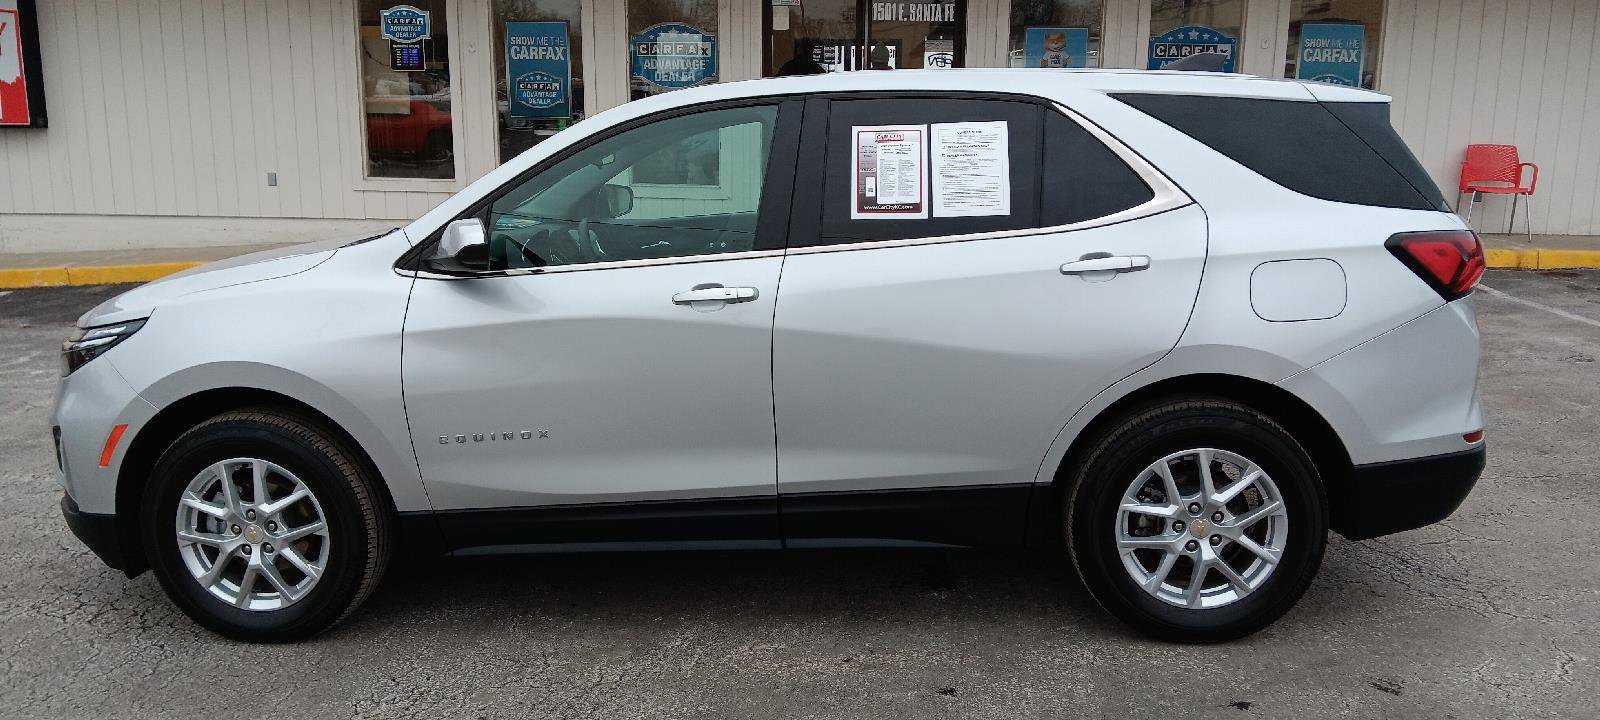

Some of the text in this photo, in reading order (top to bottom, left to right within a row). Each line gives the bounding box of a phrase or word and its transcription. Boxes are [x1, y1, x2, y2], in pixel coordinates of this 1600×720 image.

[872, 3, 955, 21] 1501 E. SANTA FE
[510, 36, 565, 46] SHOW ME THE
[1304, 39, 1359, 49] SHOW ME THE
[510, 46, 566, 60] CARFAX
[639, 44, 709, 56] CARFAX
[1303, 49, 1358, 63] CARFAX
[643, 60, 706, 70] ADVANTAGE
[655, 72, 695, 82] DEALER
[438, 429, 549, 444] EQUINOX
